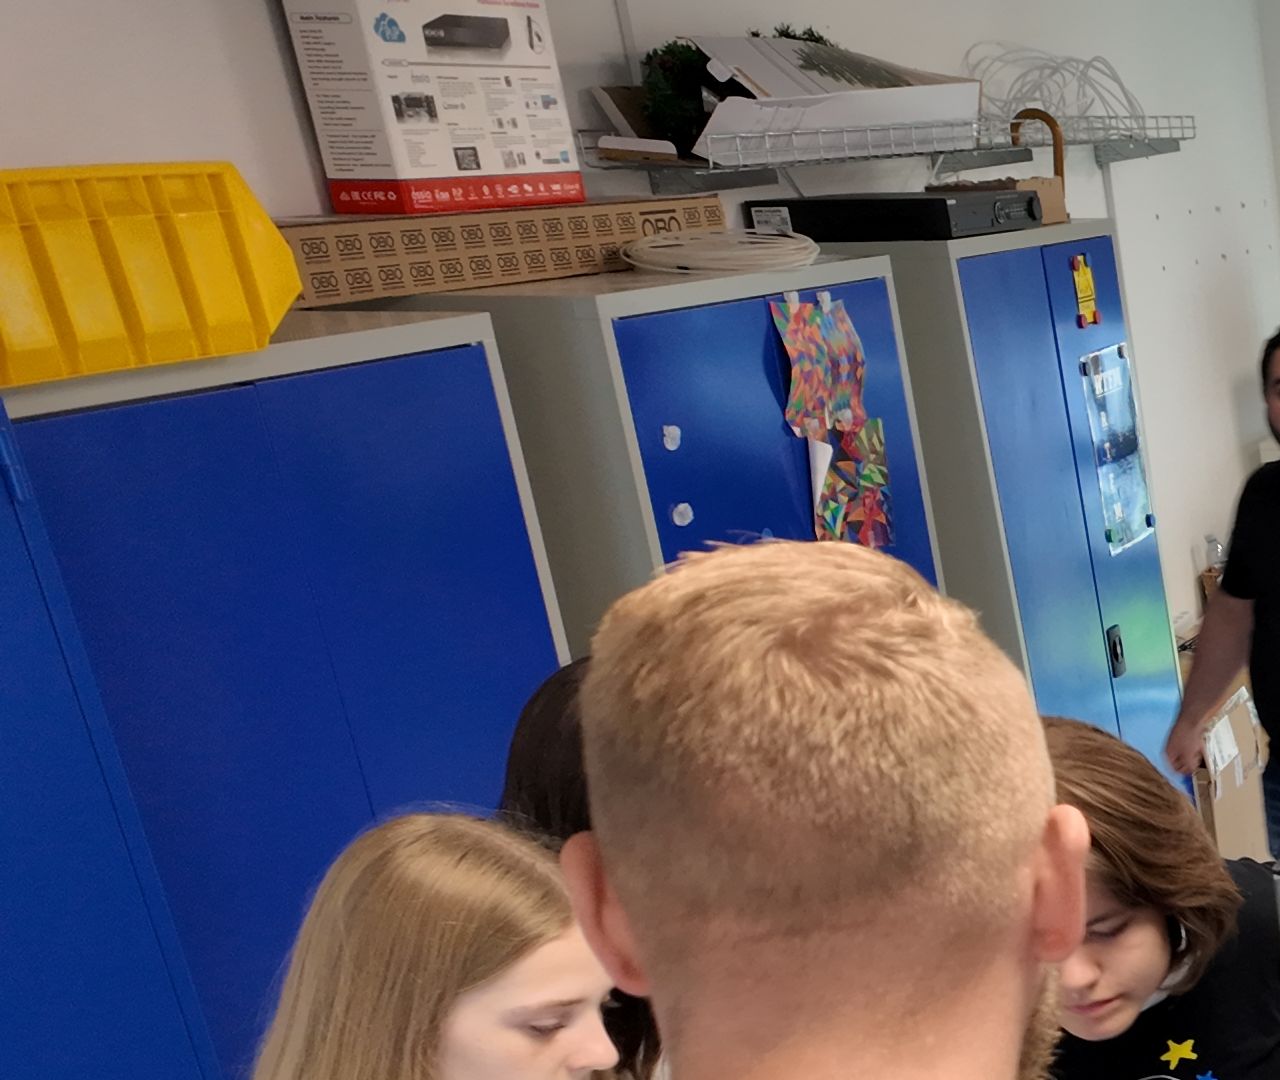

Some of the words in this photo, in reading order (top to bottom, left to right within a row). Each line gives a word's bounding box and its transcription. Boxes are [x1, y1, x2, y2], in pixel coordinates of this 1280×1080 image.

[301, 240, 328, 256] OBO
[336, 237, 363, 252] OBO
[369, 235, 395, 250] OBO
[401, 232, 426, 247] OBO
[431, 230, 455, 244] OBO
[460, 227, 484, 241] OBO
[489, 225, 511, 238] OBO
[516, 223, 538, 236] OBO
[542, 221, 563, 234] OBO
[568, 218, 588, 231] OBO
[592, 216, 612, 229] OBO
[311, 274, 338, 290] OBO
[346, 271, 372, 286] OBO
[378, 267, 403, 282] OBO
[410, 264, 434, 279] OBO
[440, 261, 463, 275] OBO
[469, 258, 492, 272] OBO
[497, 255, 519, 269] OBO
[524, 253, 546, 266] OBO
[550, 250, 571, 263] OBO
[576, 248, 596, 261] OBO
